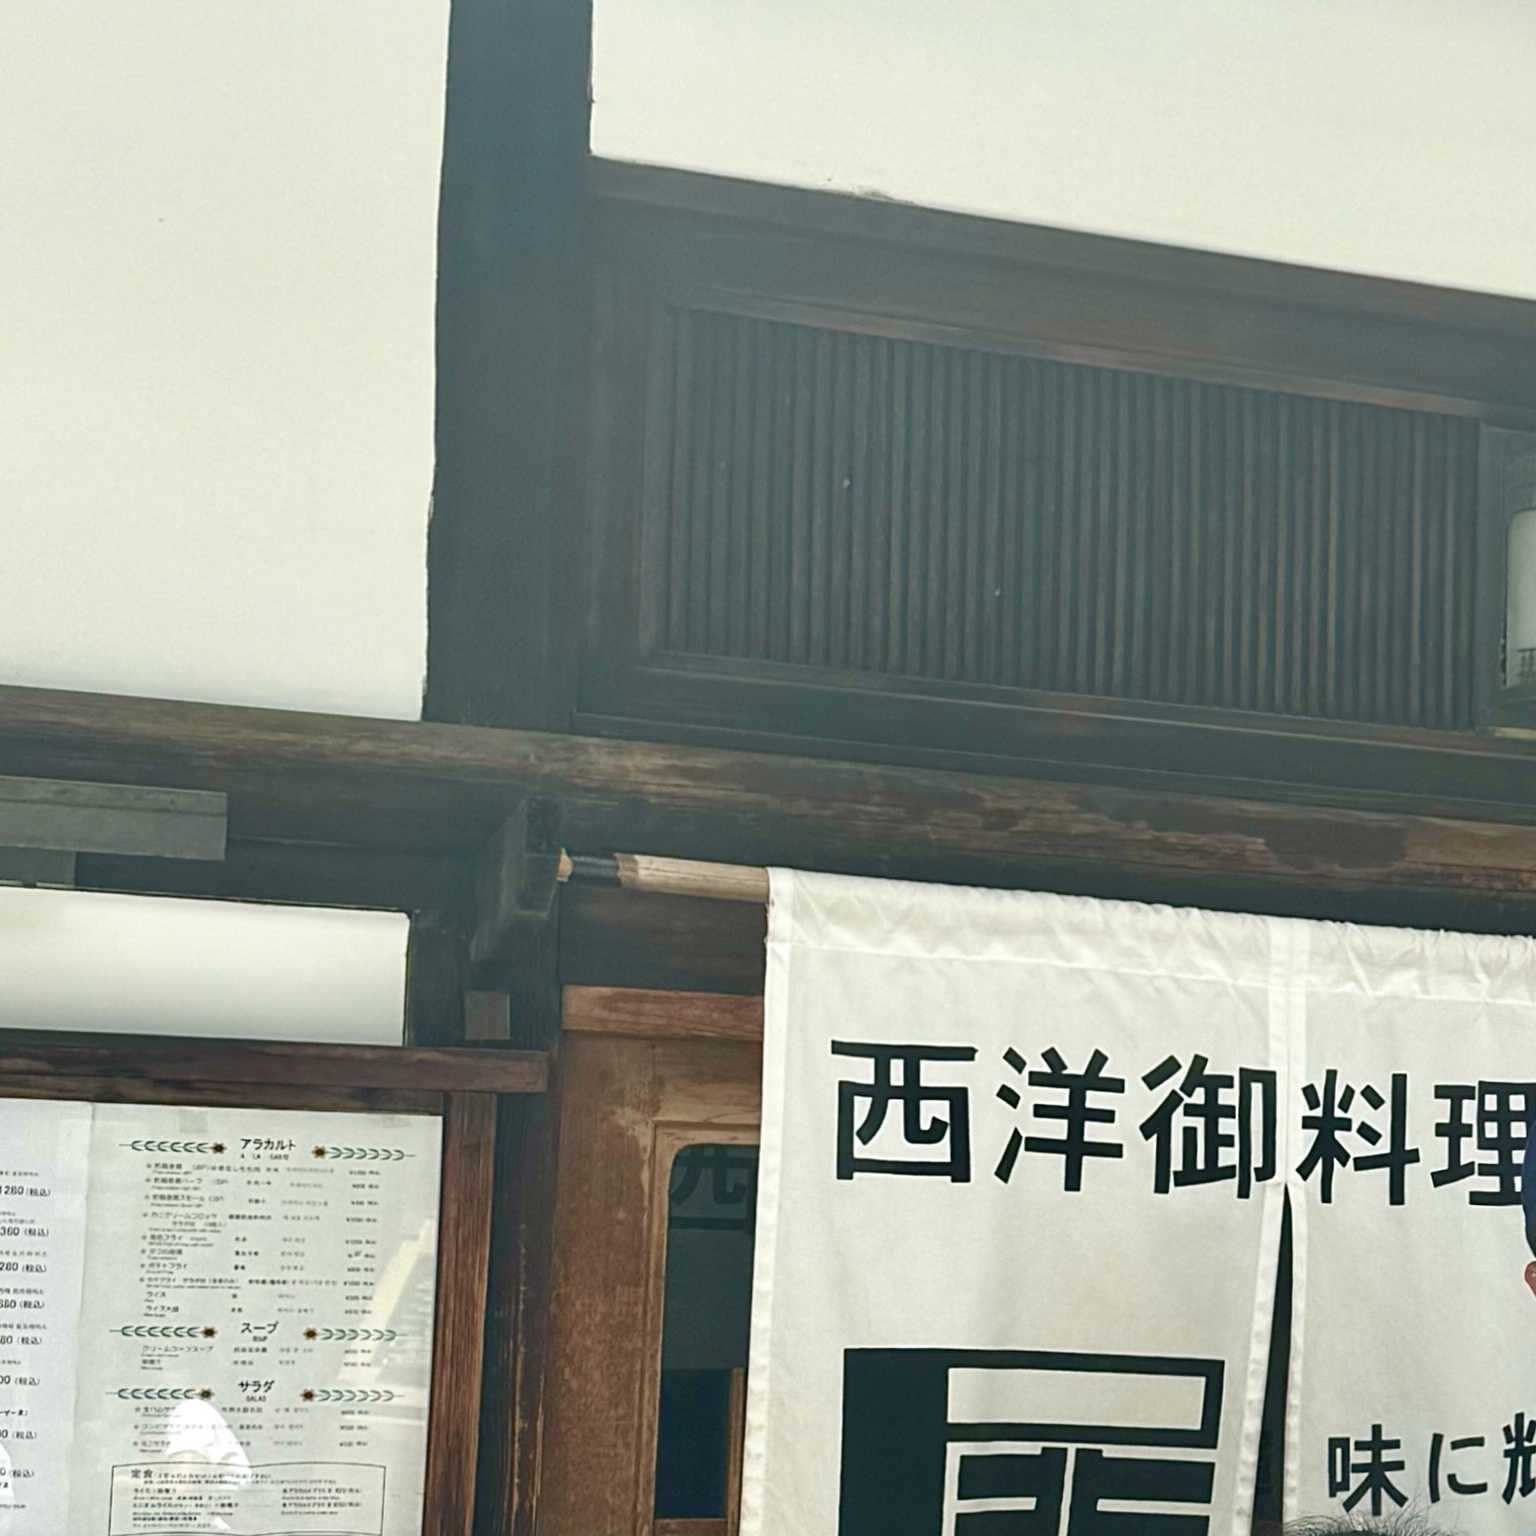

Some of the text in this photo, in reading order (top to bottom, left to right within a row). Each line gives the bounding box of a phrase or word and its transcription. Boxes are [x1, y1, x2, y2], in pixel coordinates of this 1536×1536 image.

[240, 1138, 296, 1151] アラカルト
[241, 1320, 279, 1334] スープ
[238, 1380, 275, 1393] サラダ
